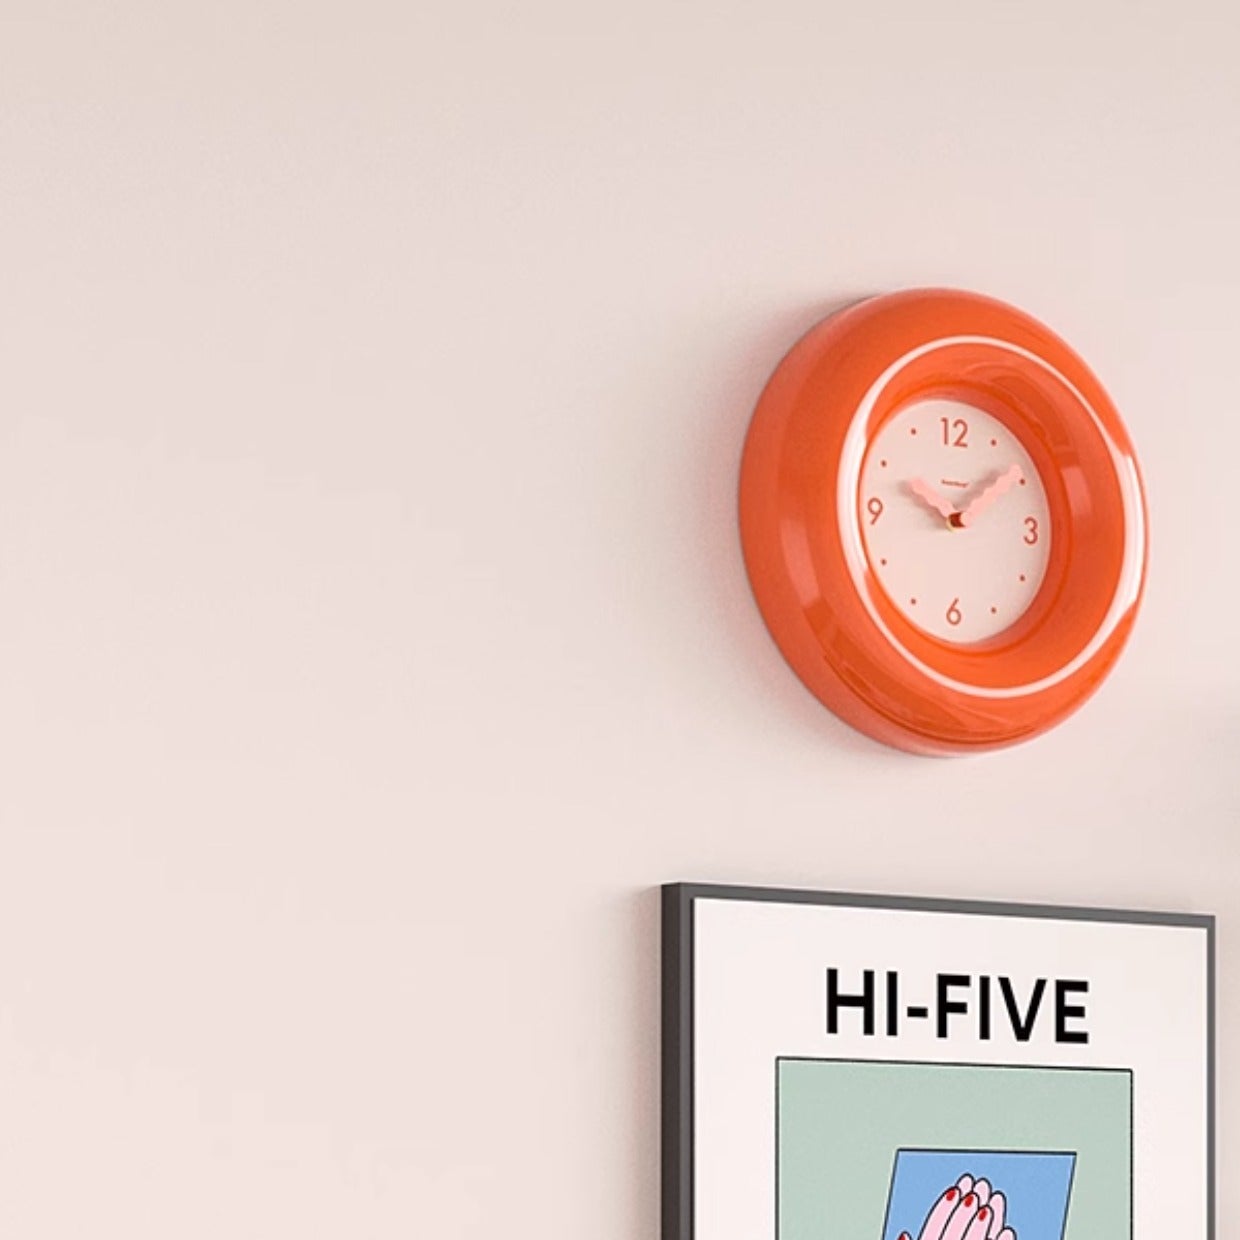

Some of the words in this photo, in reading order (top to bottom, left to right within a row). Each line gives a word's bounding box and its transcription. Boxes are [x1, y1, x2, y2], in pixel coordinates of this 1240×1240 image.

[940, 417, 969, 448] 12
[866, 496, 884, 525] 9
[1023, 517, 1038, 545] 3
[945, 597, 962, 625] 6
[826, 968, 1090, 1044] HI-FIVE
